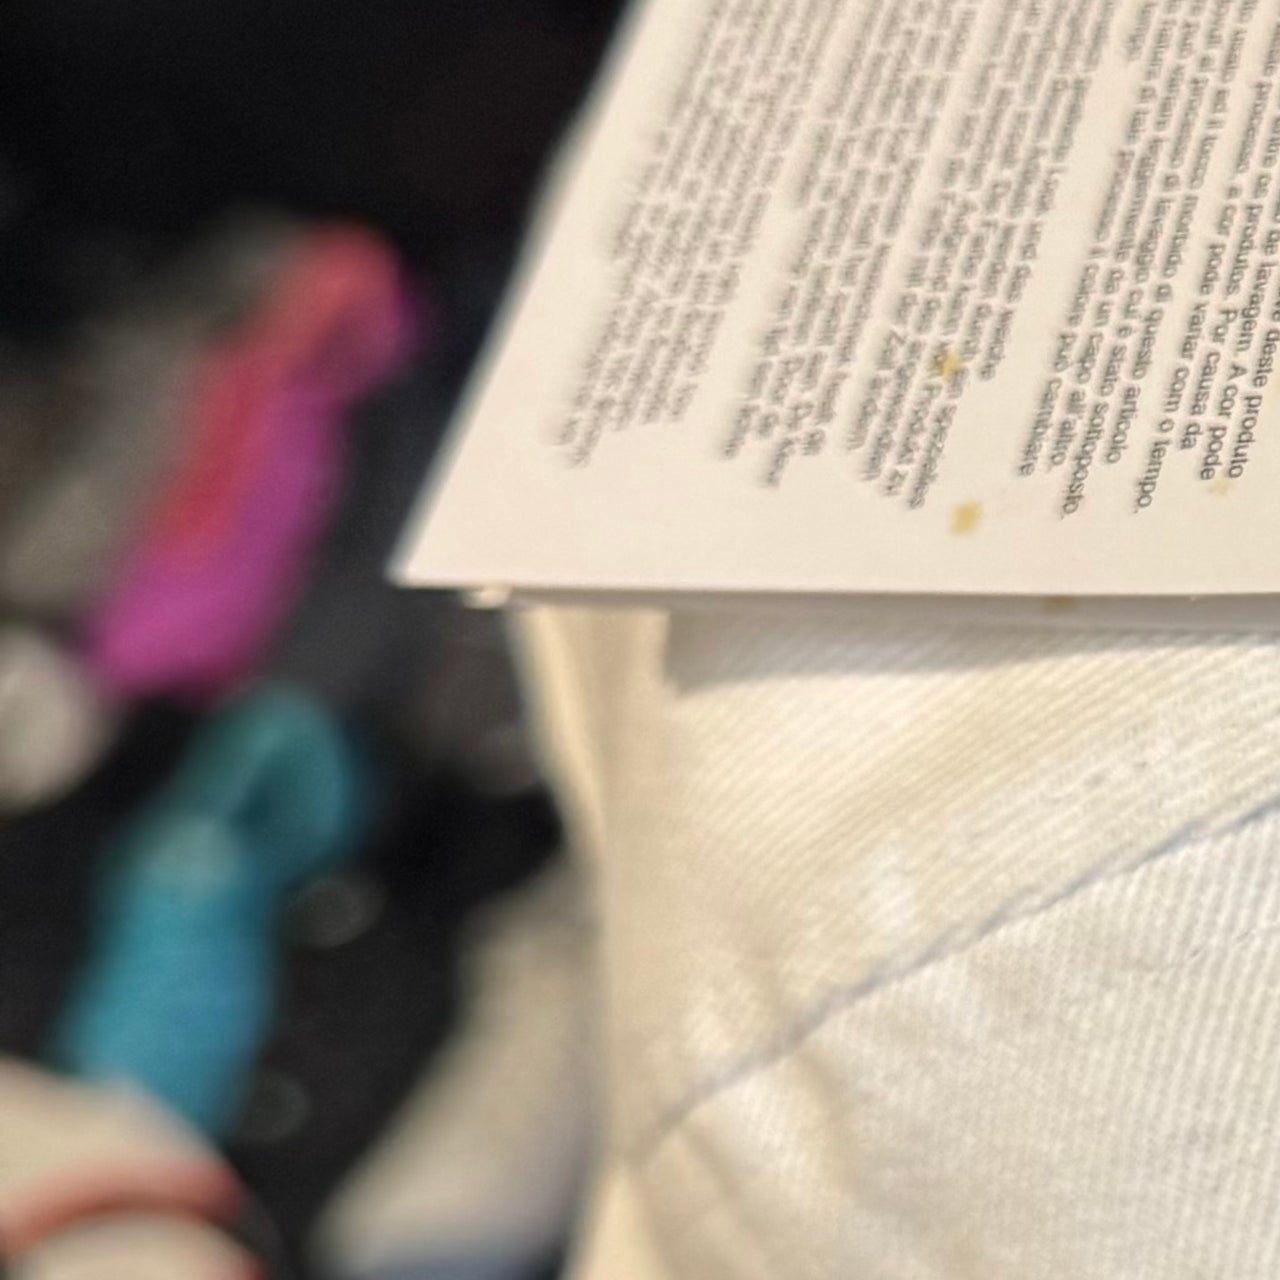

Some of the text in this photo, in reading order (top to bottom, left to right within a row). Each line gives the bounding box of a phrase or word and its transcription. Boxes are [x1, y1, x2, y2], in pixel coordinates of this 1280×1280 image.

[1195, 241, 1226, 296] pode
[1178, 300, 1208, 360] variar
[1209, 306, 1238, 345] Por
[1162, 365, 1190, 414] com
[1188, 349, 1221, 416] causa
[1225, 360, 1248, 382] A
[1155, 416, 1175, 434] o
[1215, 383, 1239, 419] cor
[1177, 420, 1203, 451] da
[1197, 423, 1228, 481] pode
[1223, 393, 1263, 479] produto
